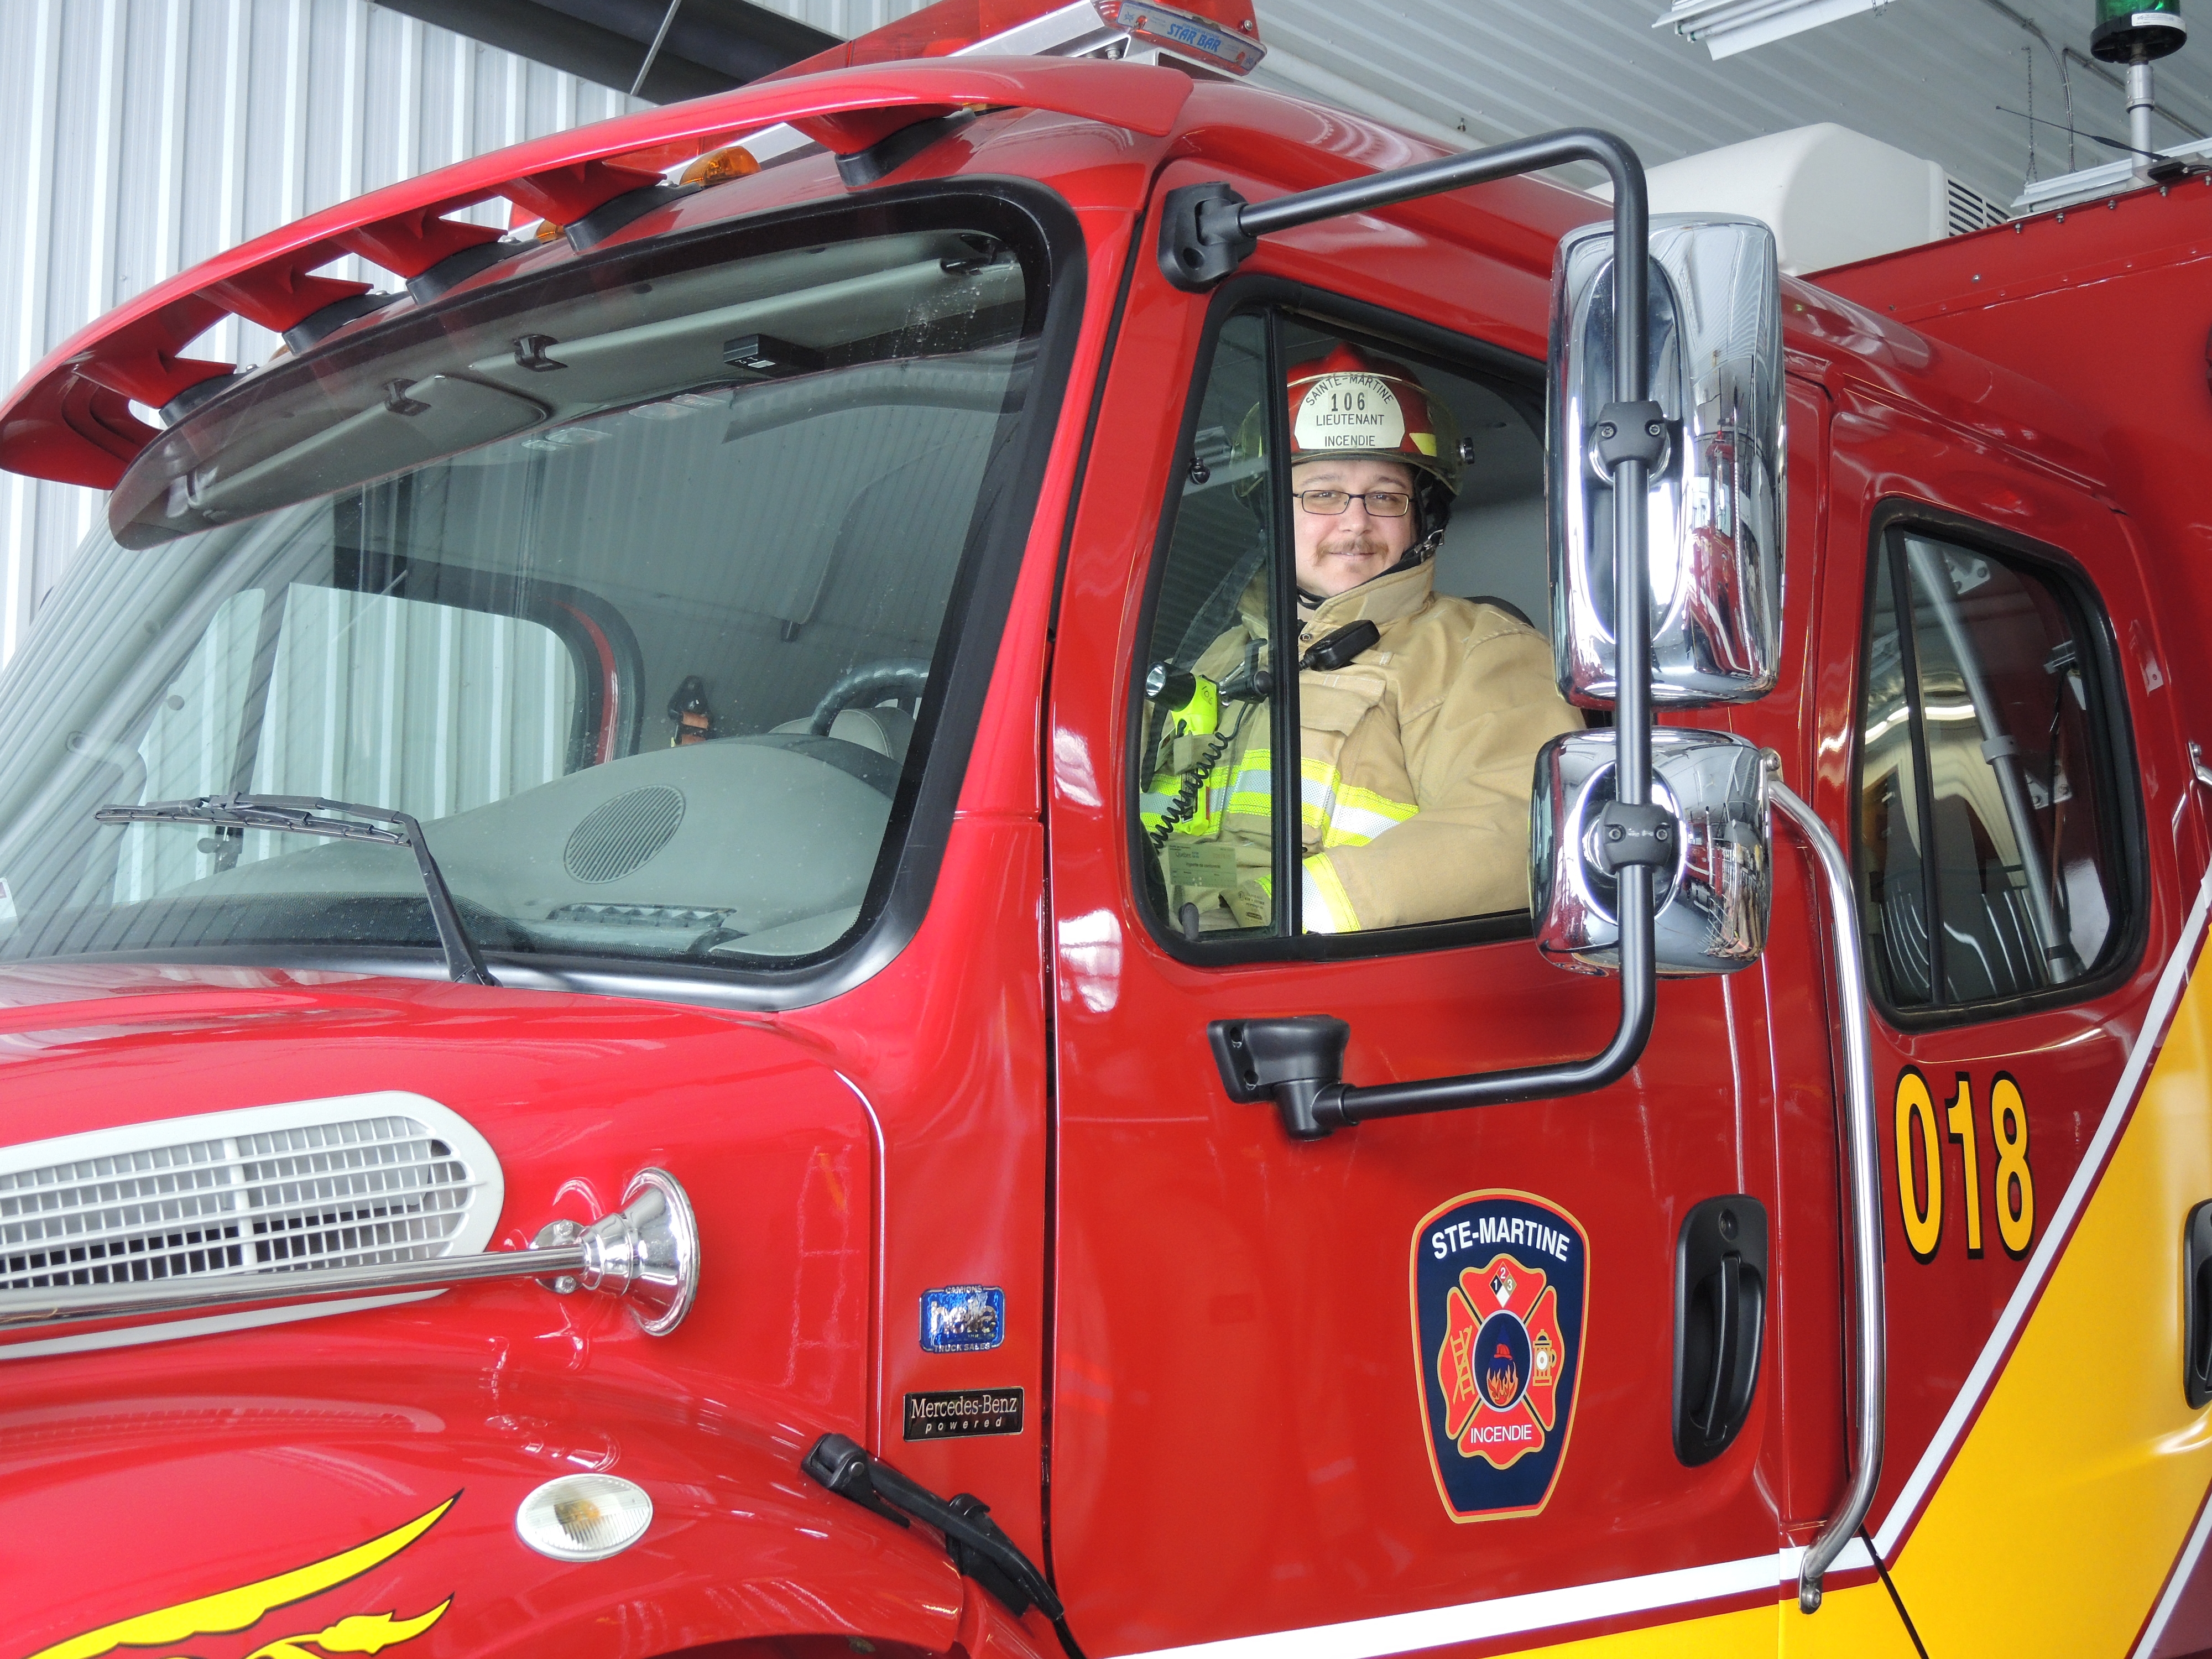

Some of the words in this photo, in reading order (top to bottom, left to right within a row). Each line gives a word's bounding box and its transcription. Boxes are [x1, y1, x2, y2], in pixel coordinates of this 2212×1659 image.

[1167, 23, 1197, 45] STAR
[1197, 34, 1222, 52] BAR
[1306, 373, 1394, 406] SAINTE-MARTINE
[1331, 392, 1365, 412] 106
[1316, 414, 1385, 426] LIEUTENANT
[1324, 435, 1376, 447] INCENDIE
[1201, 686, 1213, 705] 106
[1893, 1064, 2036, 1265] 018
[1432, 1217, 1571, 1262] STE-MARTINE
[1500, 1267, 1506, 1280] 2
[1494, 1279, 1498, 1291] 1
[1507, 1279, 1513, 1291] 3
[935, 1344, 962, 1353] TRUCK
[964, 1342, 990, 1350] SALES
[911, 1394, 1018, 1418] Mercedes-Benz
[925, 1417, 1002, 1434] powered
[1470, 1424, 1532, 1444] INCENDIE
